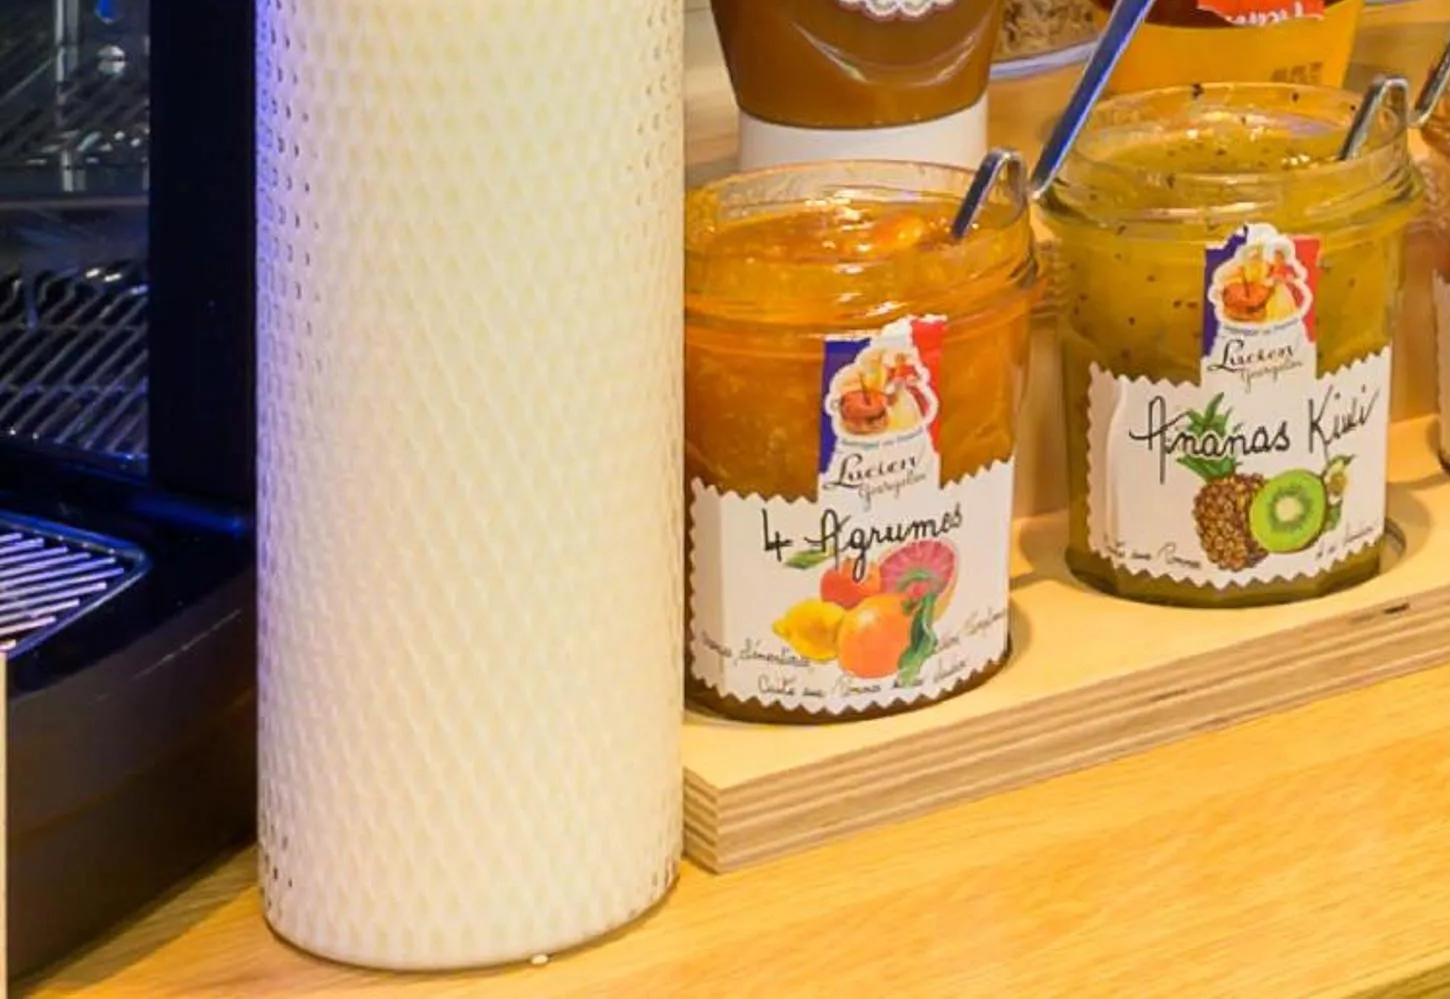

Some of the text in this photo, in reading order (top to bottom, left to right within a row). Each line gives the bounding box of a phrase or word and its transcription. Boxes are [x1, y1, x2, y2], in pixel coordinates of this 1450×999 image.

[1206, 338, 1297, 374] Lucien
[821, 449, 924, 490] Lucien
[1128, 395, 1291, 486] Ananas
[762, 502, 964, 584] 4 Agrumes
